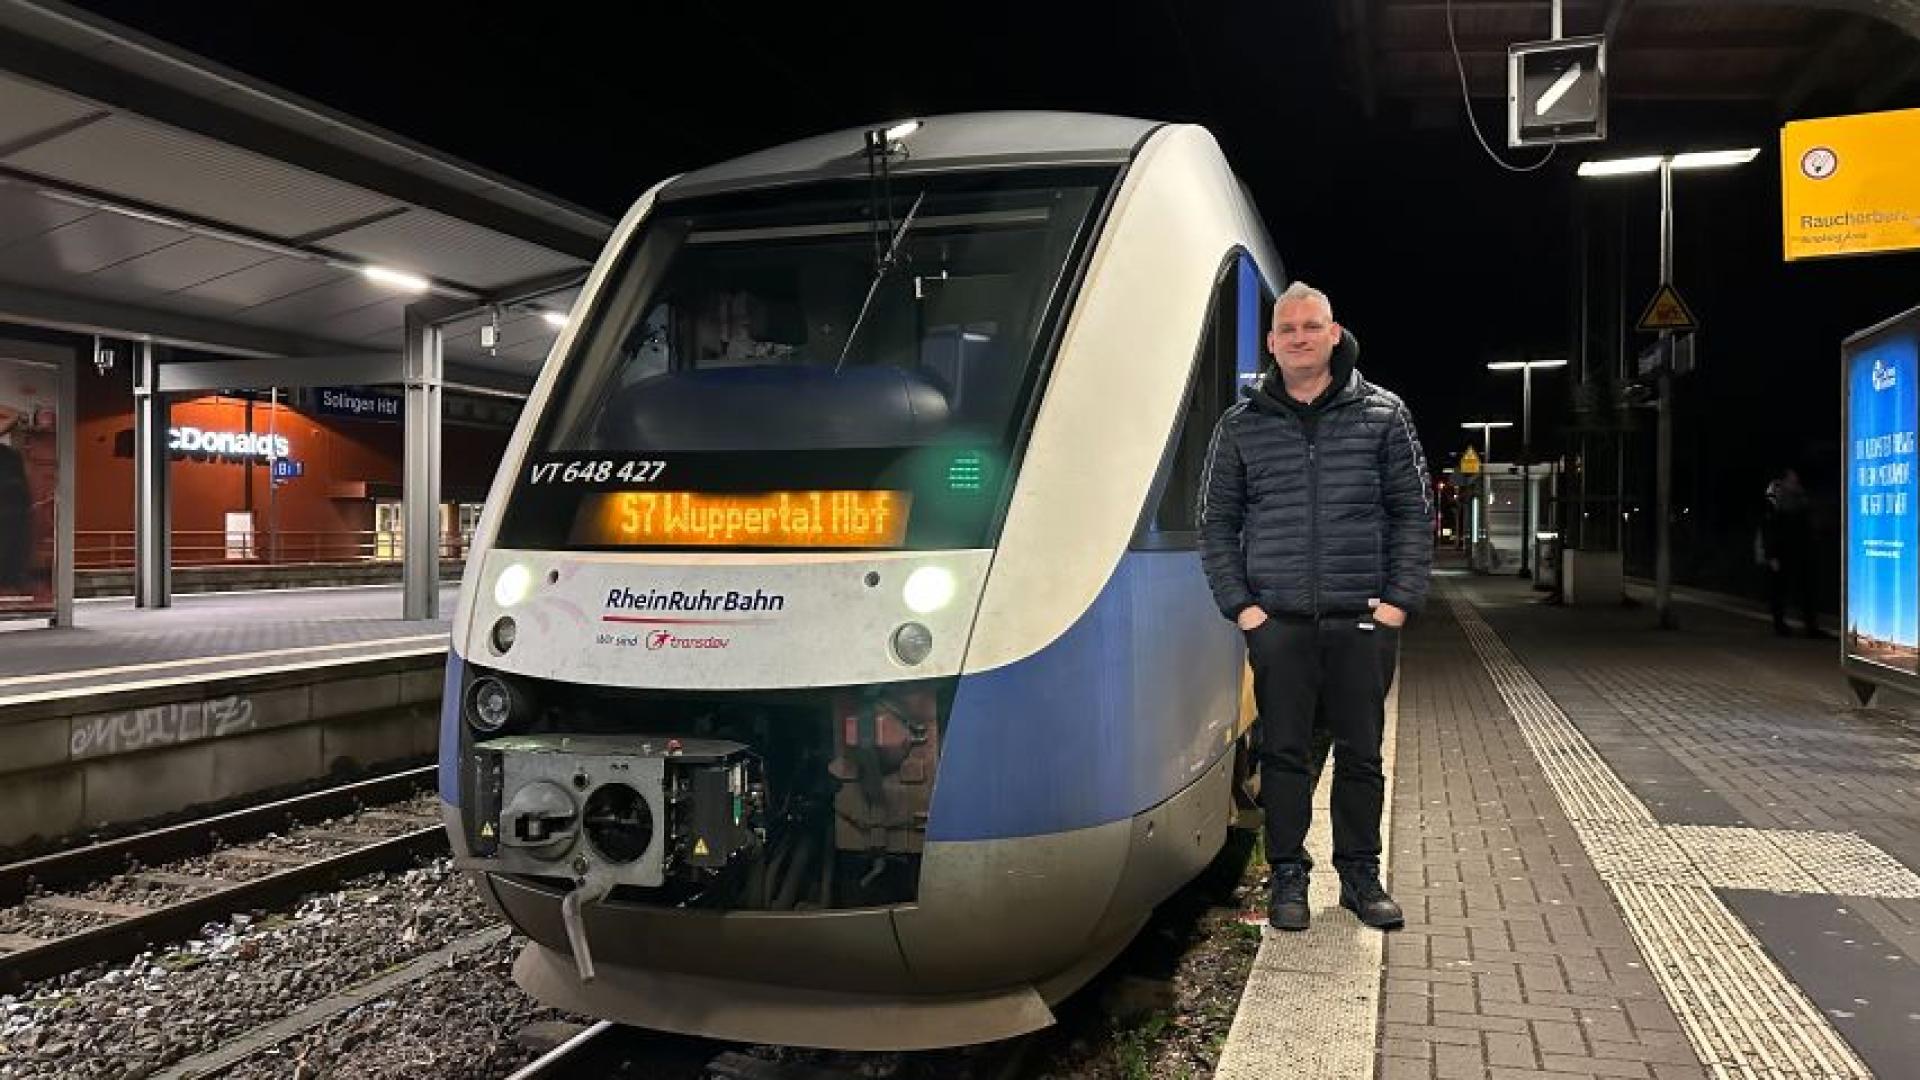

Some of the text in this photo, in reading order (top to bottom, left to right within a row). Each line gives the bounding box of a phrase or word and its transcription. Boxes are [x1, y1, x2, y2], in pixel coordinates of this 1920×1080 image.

[323, 391, 397, 415] Solingen Hbf
[168, 427, 289, 457] cDonald's
[531, 460, 667, 485] VT 648 427
[620, 491, 891, 538] S7 Wuppertal Hbf
[605, 587, 784, 612] RheinRuhrBahn
[615, 635, 638, 647] sind
[670, 636, 730, 649] transdev
